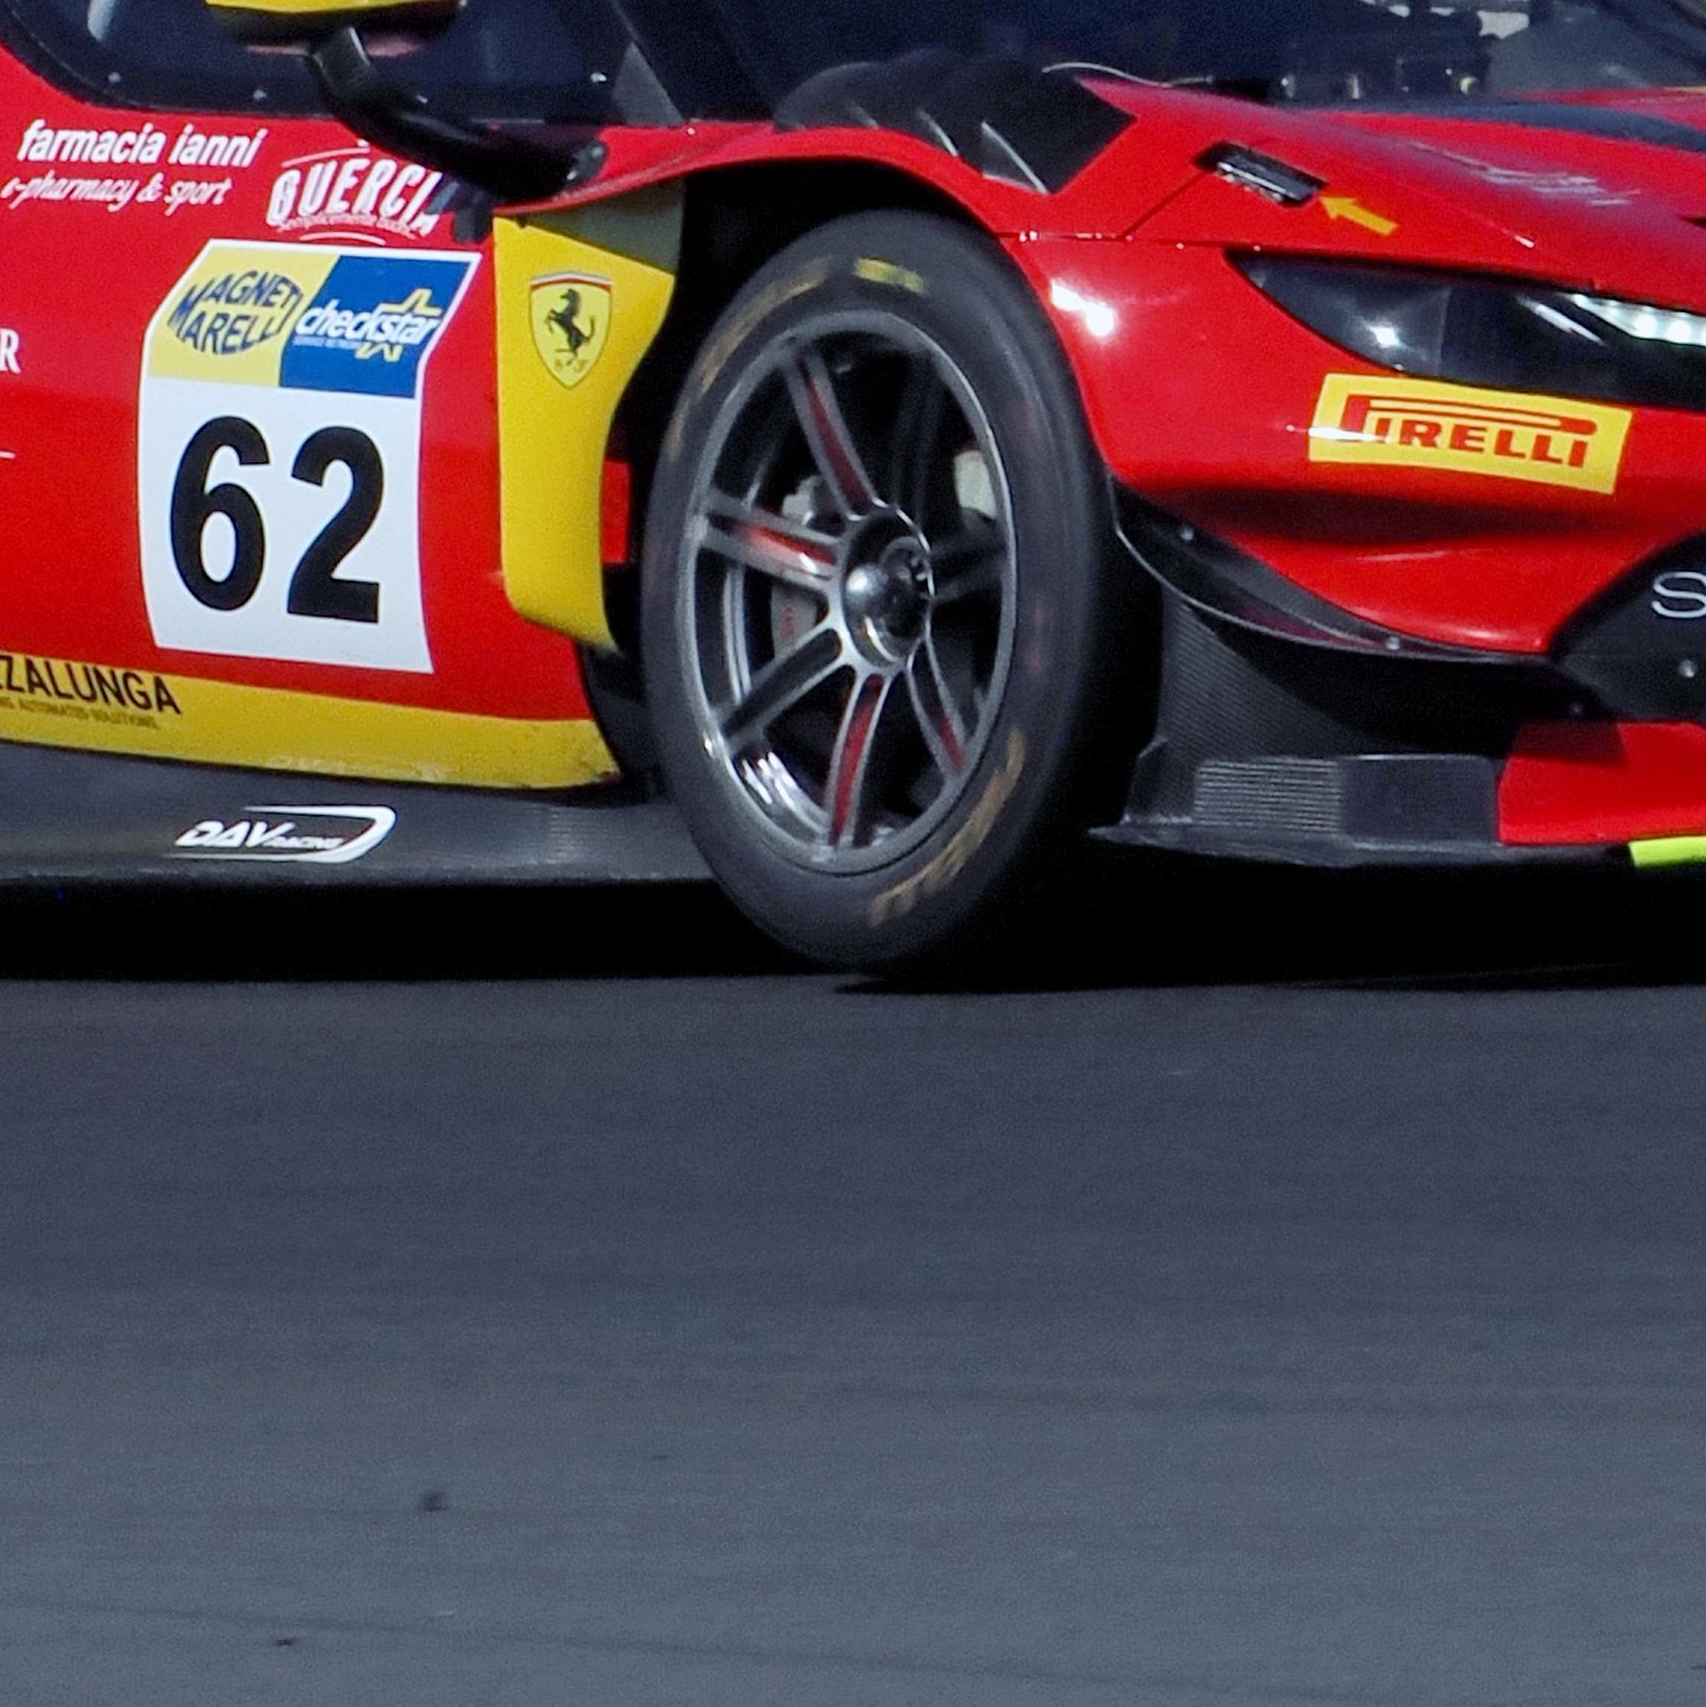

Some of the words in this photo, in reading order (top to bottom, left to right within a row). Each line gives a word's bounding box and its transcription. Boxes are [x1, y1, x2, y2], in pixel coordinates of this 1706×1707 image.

[17, 119, 166, 163] farmacia
[168, 123, 268, 167] ianni
[0, 169, 139, 212] e-pharmacy
[136, 172, 165, 202] &
[163, 177, 233, 217] sport
[295, 299, 442, 345] checkstar
[1342, 393, 1597, 469] PIRELLI
[170, 415, 384, 623] 62
